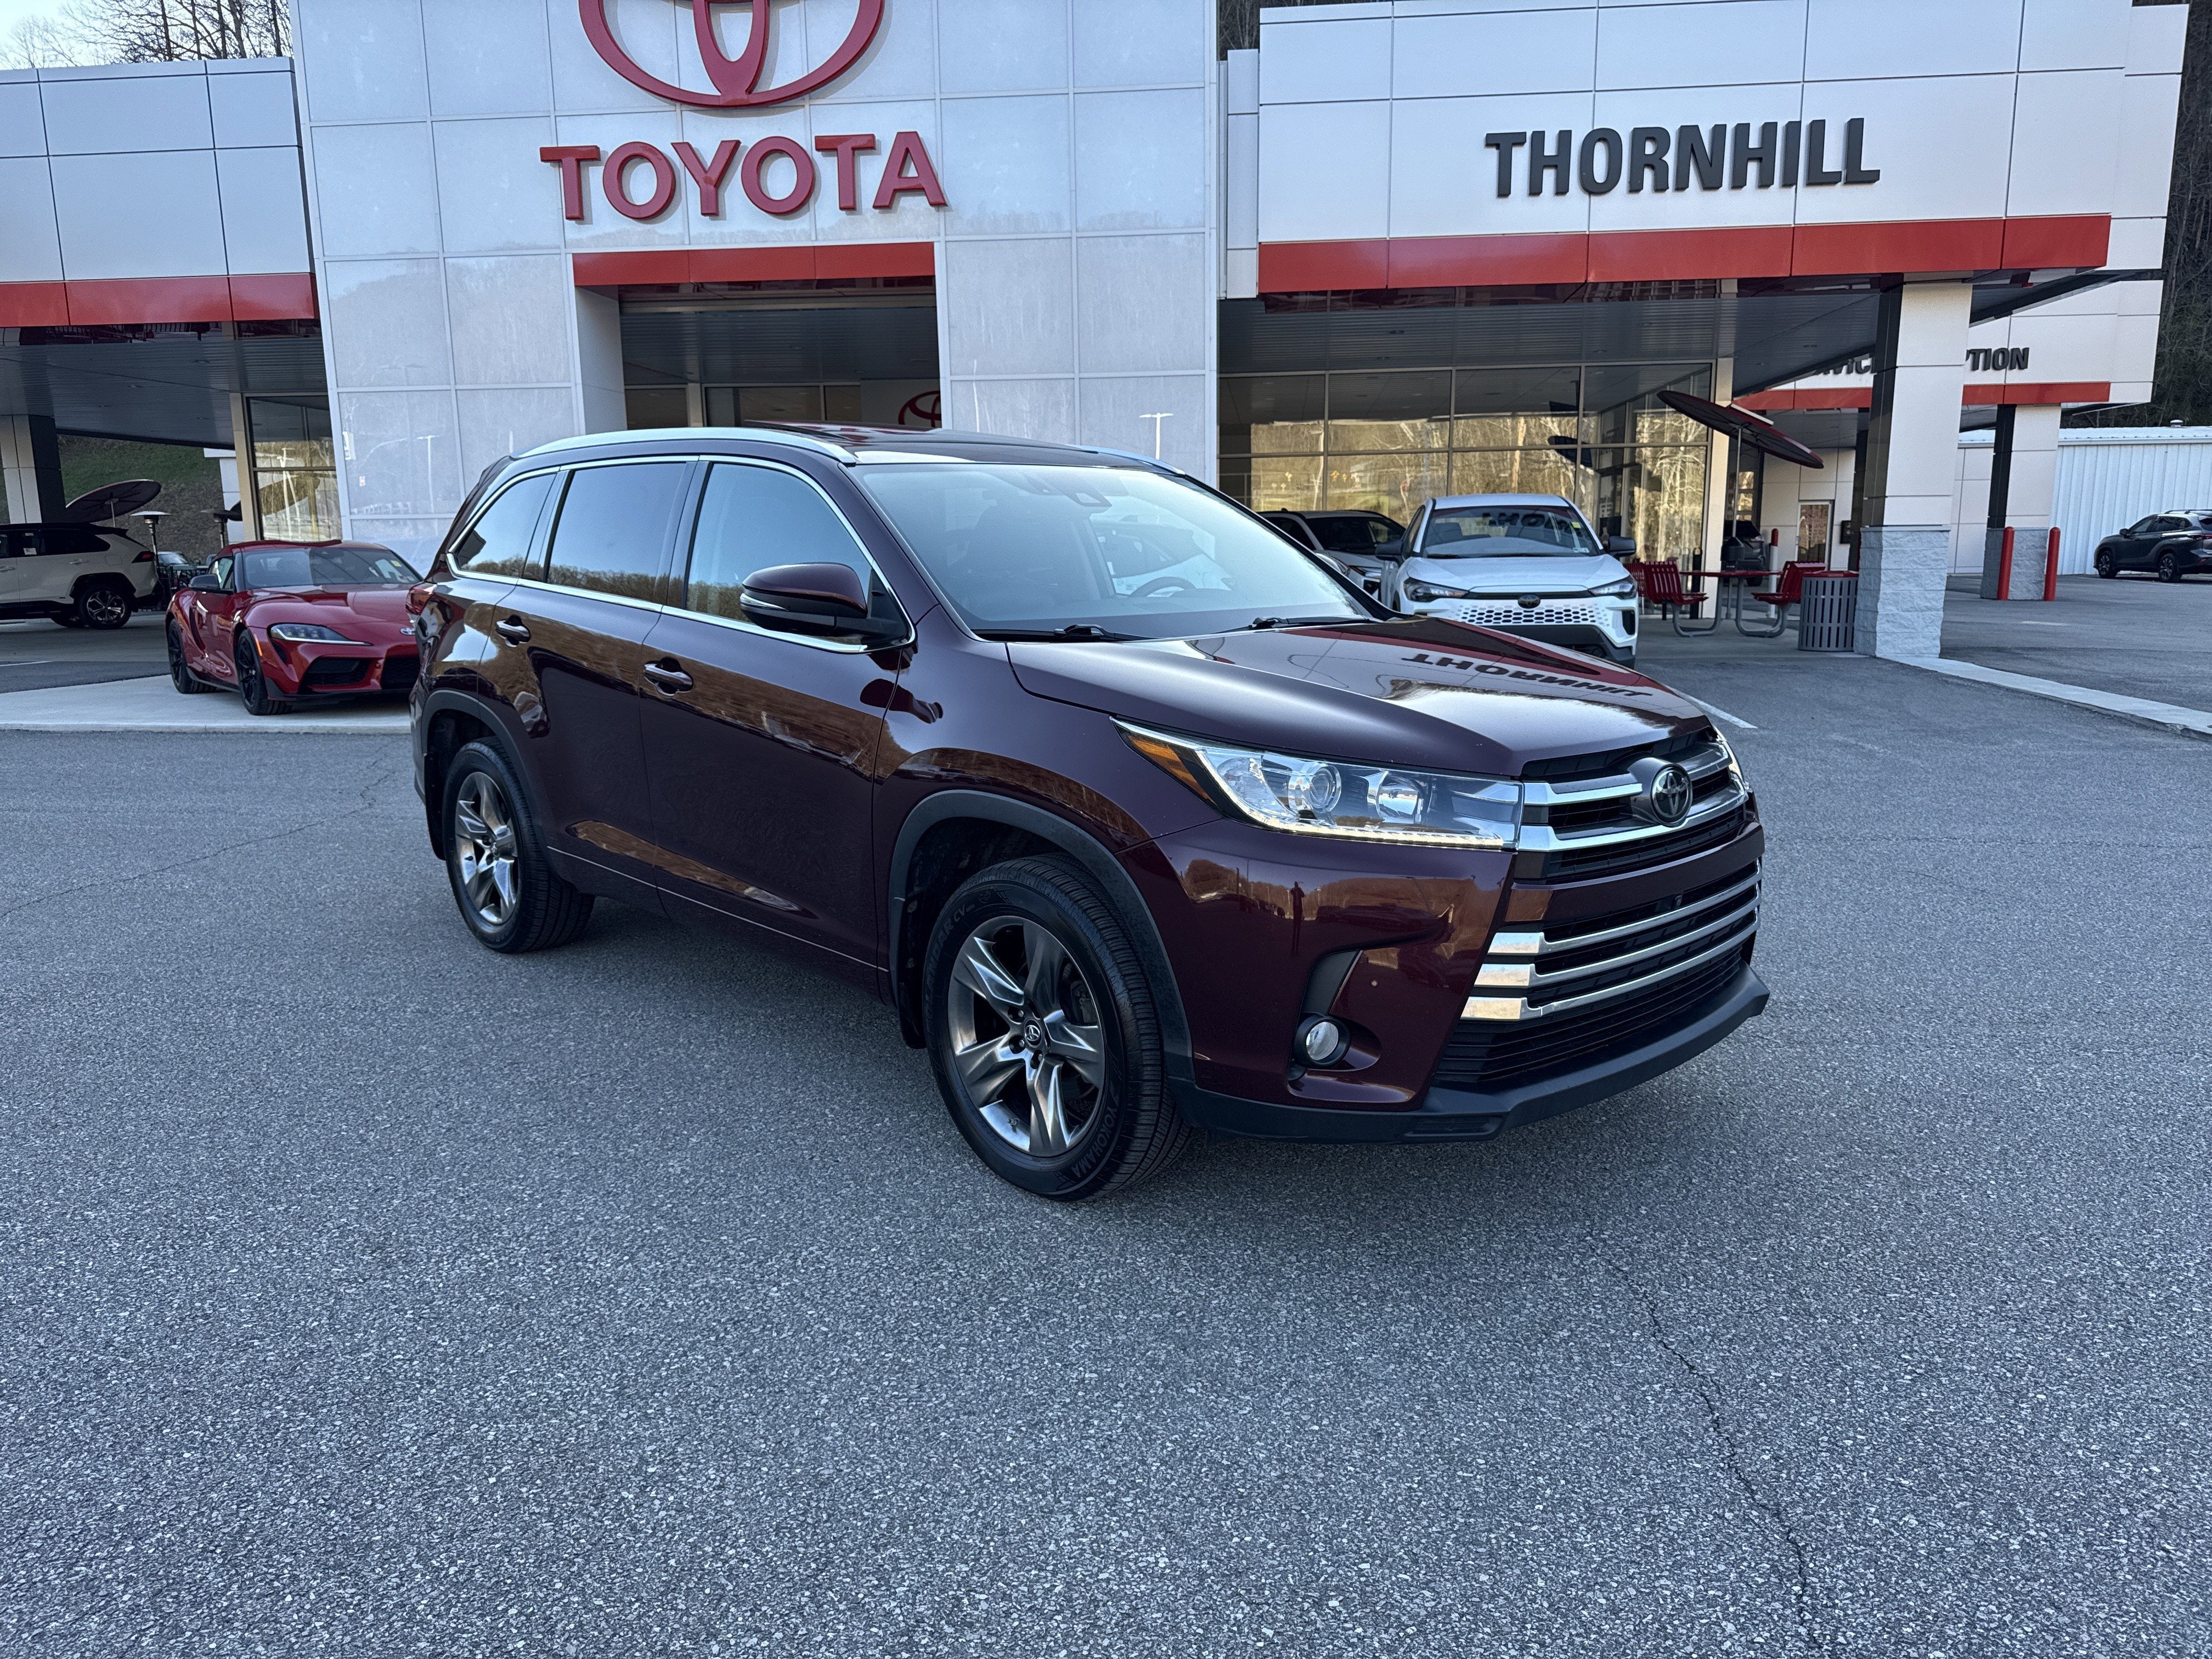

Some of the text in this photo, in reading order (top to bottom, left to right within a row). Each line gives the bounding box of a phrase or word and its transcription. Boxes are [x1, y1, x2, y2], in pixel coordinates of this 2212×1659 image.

[539, 131, 948, 221] TOYOTA
[1485, 117, 1881, 198] THORNHILL
[1070, 1105, 1119, 1178] YOKOHAMA
